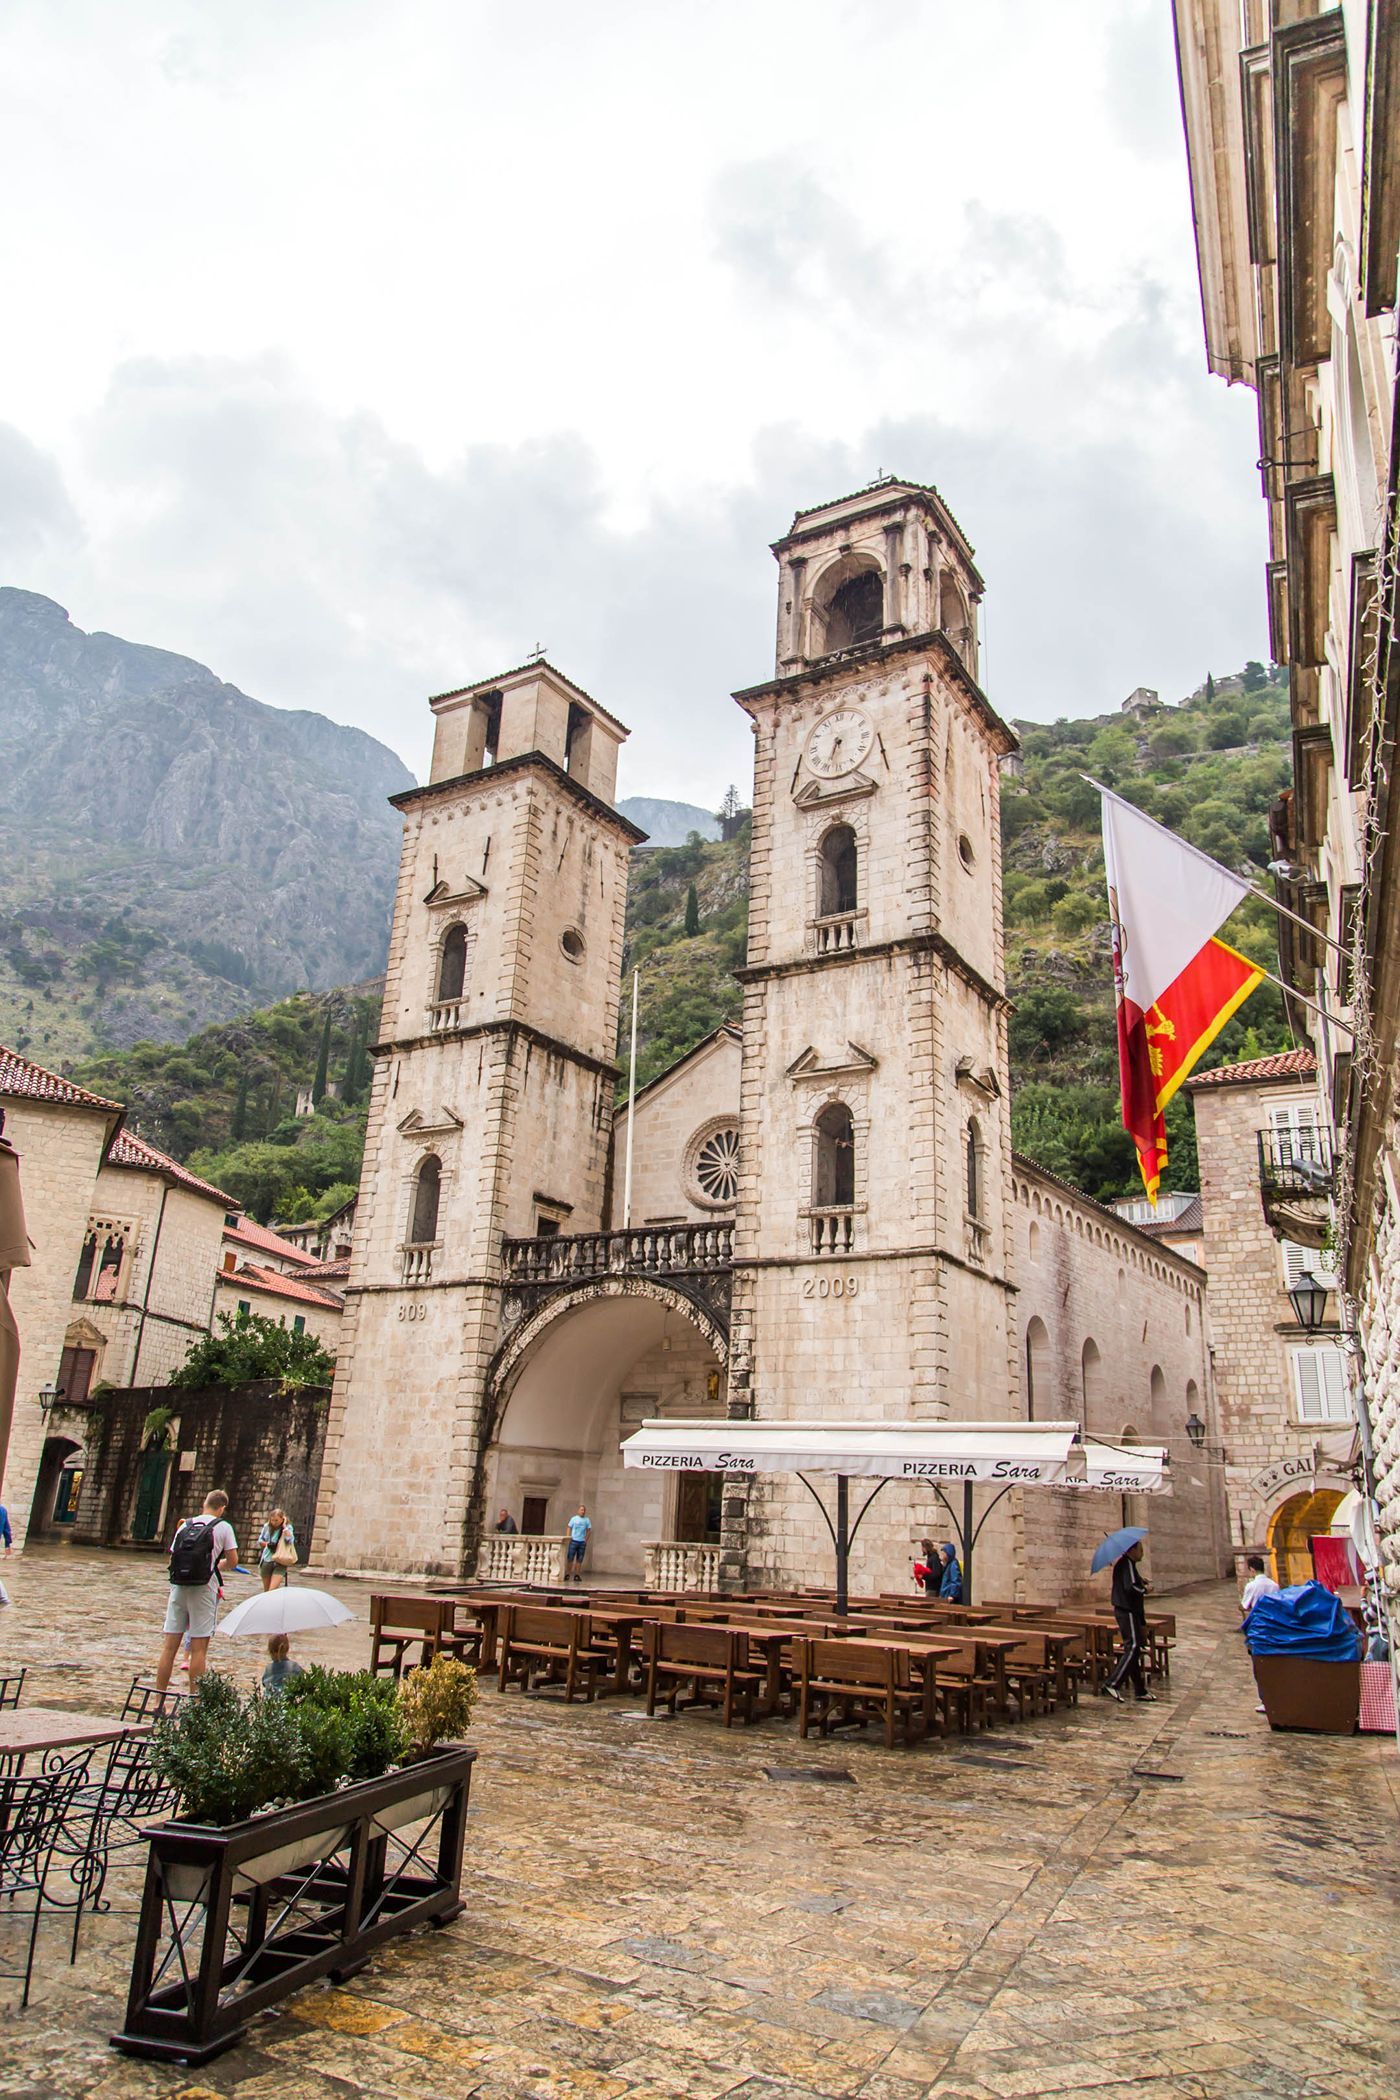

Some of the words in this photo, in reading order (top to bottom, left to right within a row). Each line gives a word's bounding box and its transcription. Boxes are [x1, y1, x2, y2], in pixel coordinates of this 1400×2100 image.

[803, 1276, 859, 1299] 2009
[398, 1303, 427, 1321] 809
[642, 1455, 703, 1467] PIZZERIA
[715, 1453, 756, 1469] Sara
[903, 1463, 977, 1476] PIZZERIA
[992, 1461, 1041, 1479] Sara
[1100, 1472, 1140, 1486] Sara
